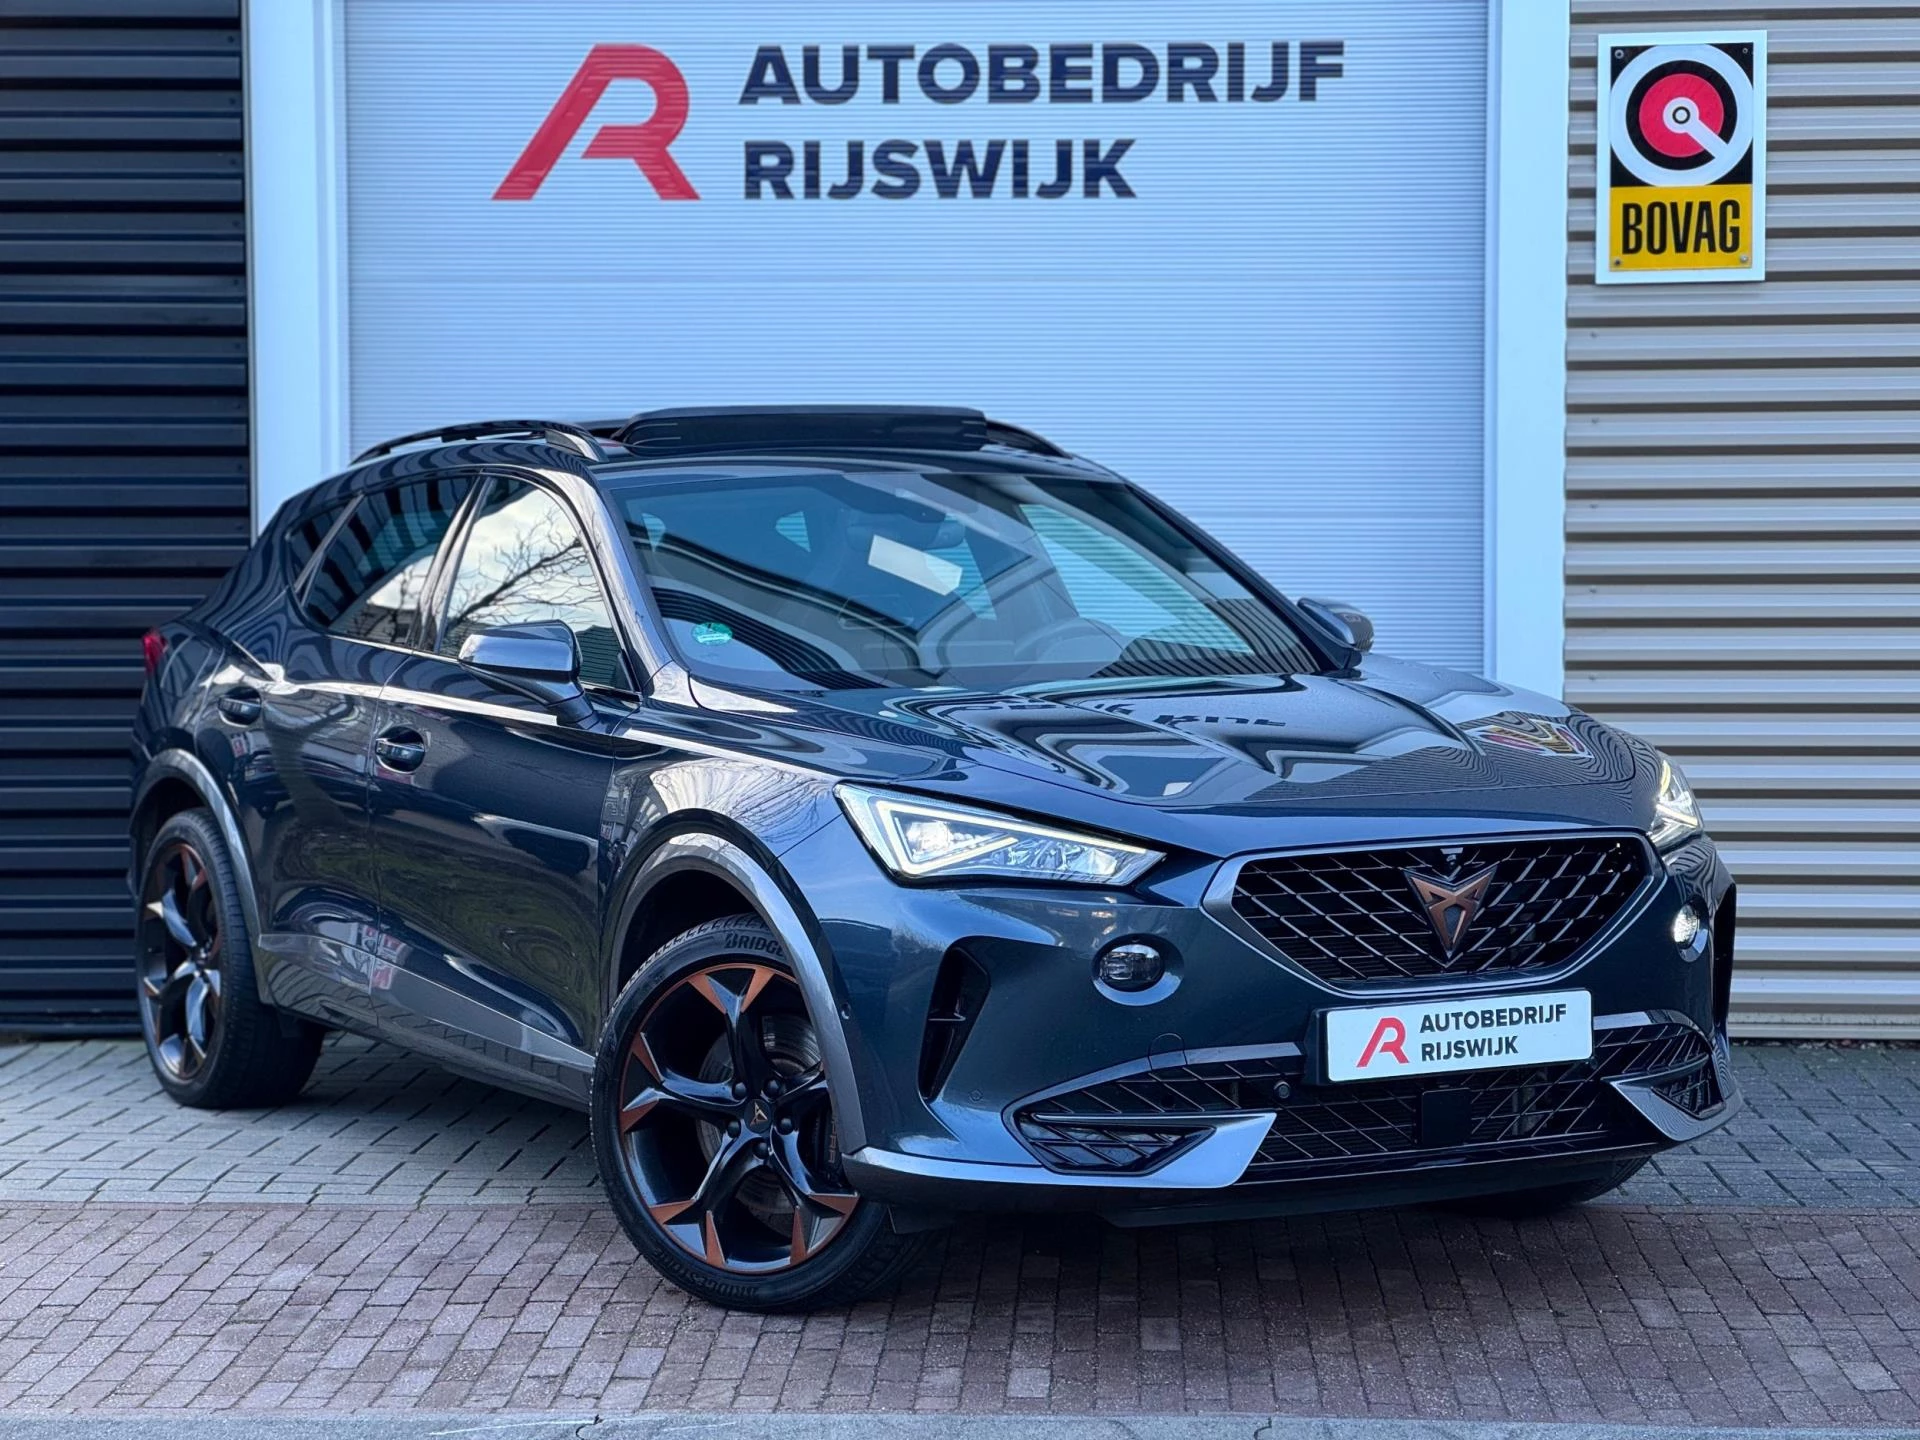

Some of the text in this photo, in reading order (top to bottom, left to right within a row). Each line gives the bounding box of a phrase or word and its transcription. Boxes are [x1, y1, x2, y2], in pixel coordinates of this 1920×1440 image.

[739, 41, 1344, 106] AUTOBEDRIJF
[743, 138, 1137, 200] RIJSWIJK
[1622, 199, 1741, 255] BOVAG
[1419, 1003, 1567, 1033] AUTOBEDRIJF
[1421, 1036, 1519, 1062] RIJSWIJK
